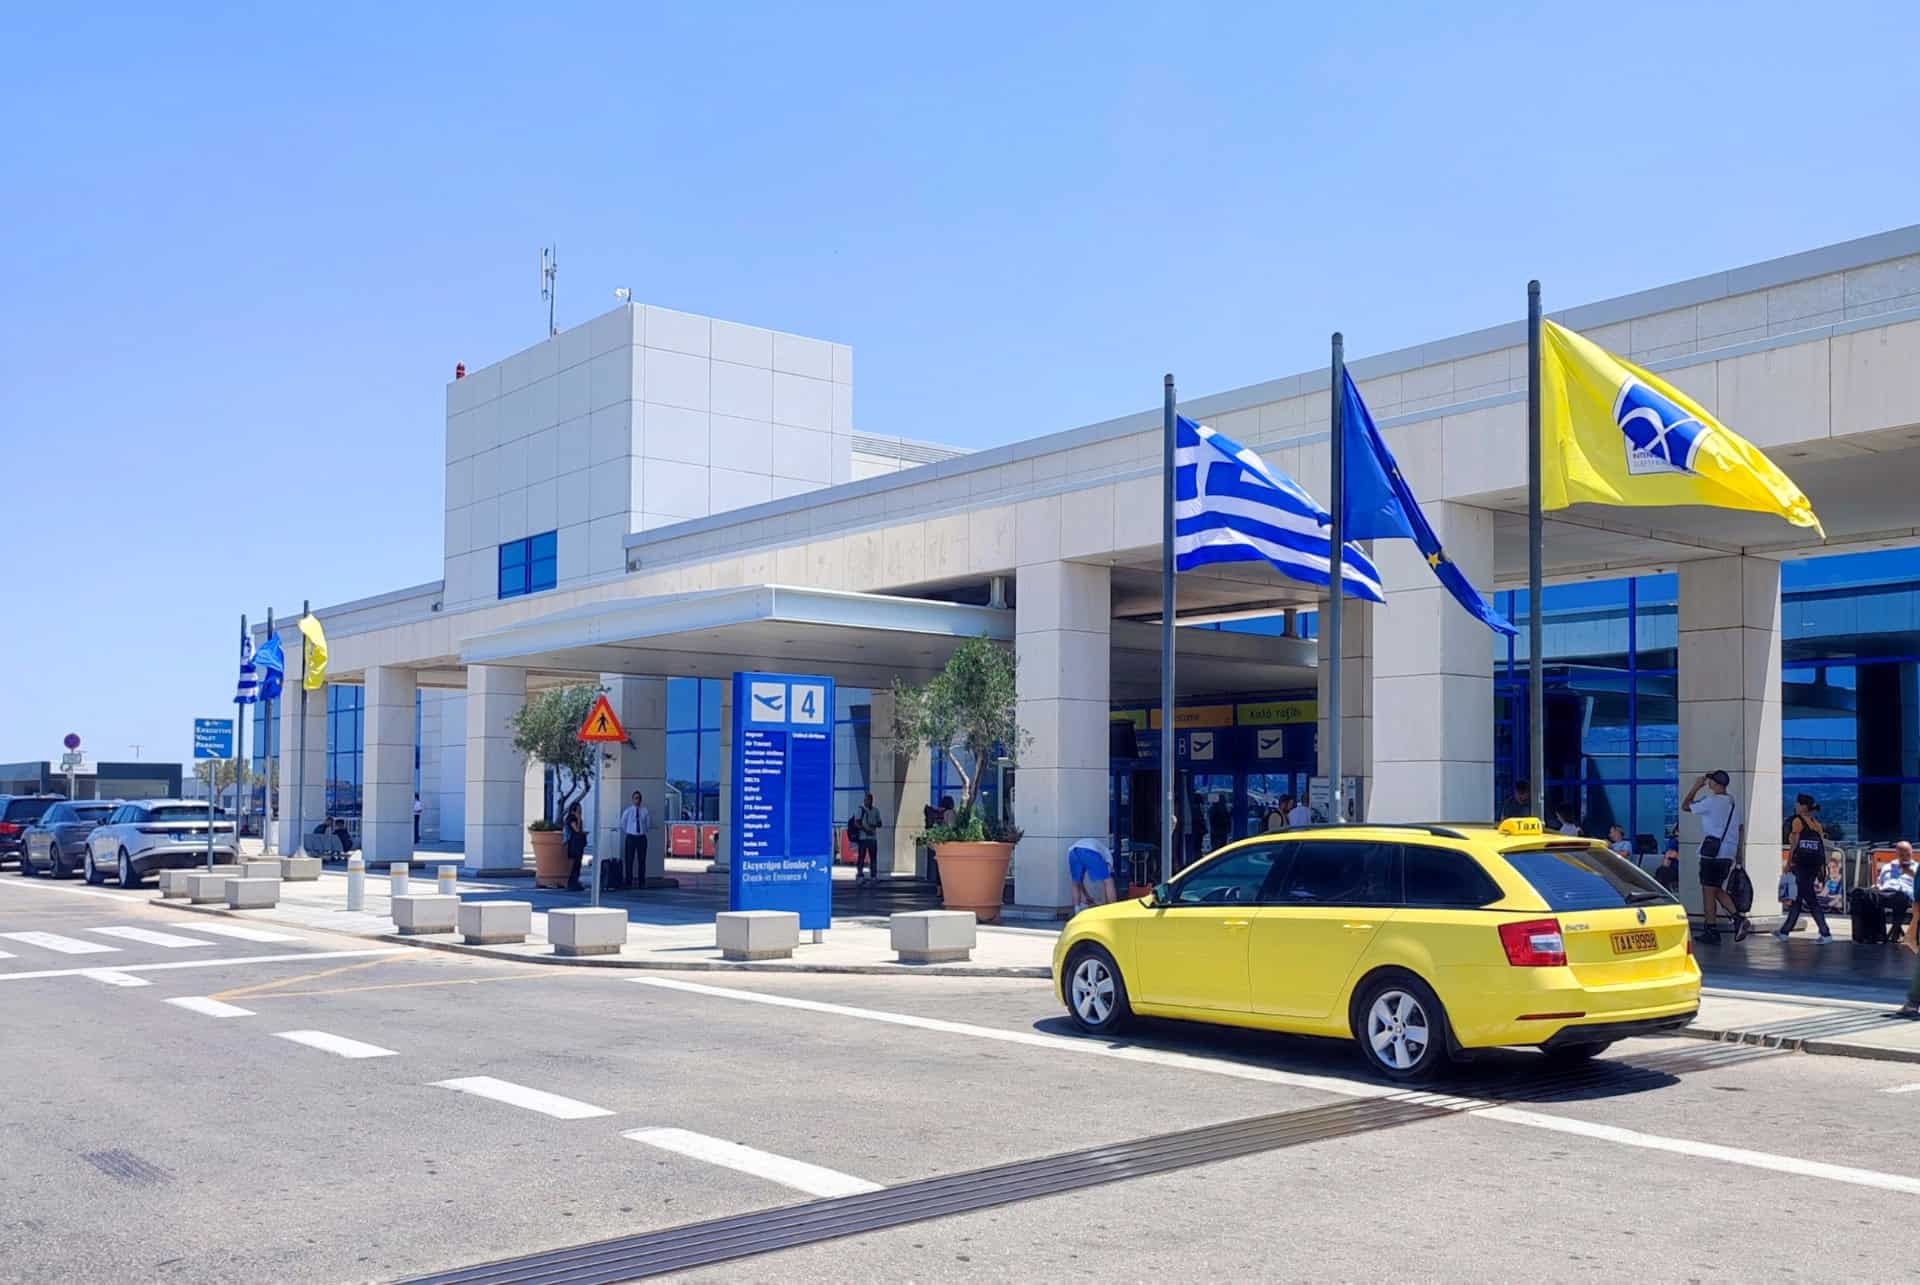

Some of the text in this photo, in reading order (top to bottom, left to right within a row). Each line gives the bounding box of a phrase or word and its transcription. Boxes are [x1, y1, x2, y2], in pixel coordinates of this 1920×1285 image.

[802, 690, 815, 718] 4
[1517, 820, 1540, 831] Taxi
[742, 872, 808, 882] Check-in Entrance 4
